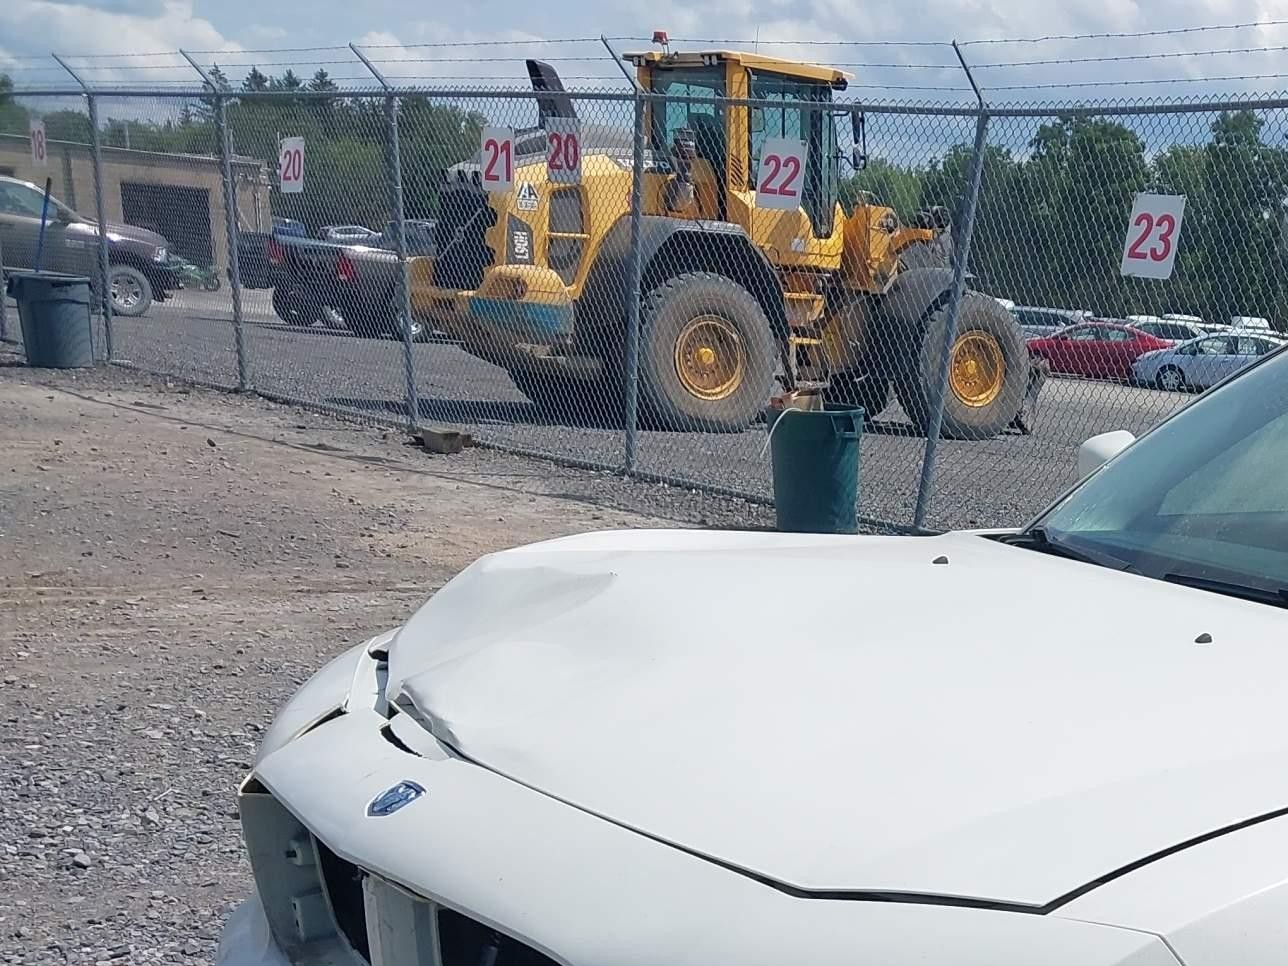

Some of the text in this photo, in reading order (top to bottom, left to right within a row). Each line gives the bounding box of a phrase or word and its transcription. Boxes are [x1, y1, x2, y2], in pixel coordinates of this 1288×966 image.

[32, 130, 46, 161] 18
[283, 149, 301, 181] 20
[484, 138, 512, 182] 21
[549, 132, 579, 171] 20
[760, 154, 801, 197] 22
[1128, 213, 1175, 261] 23
